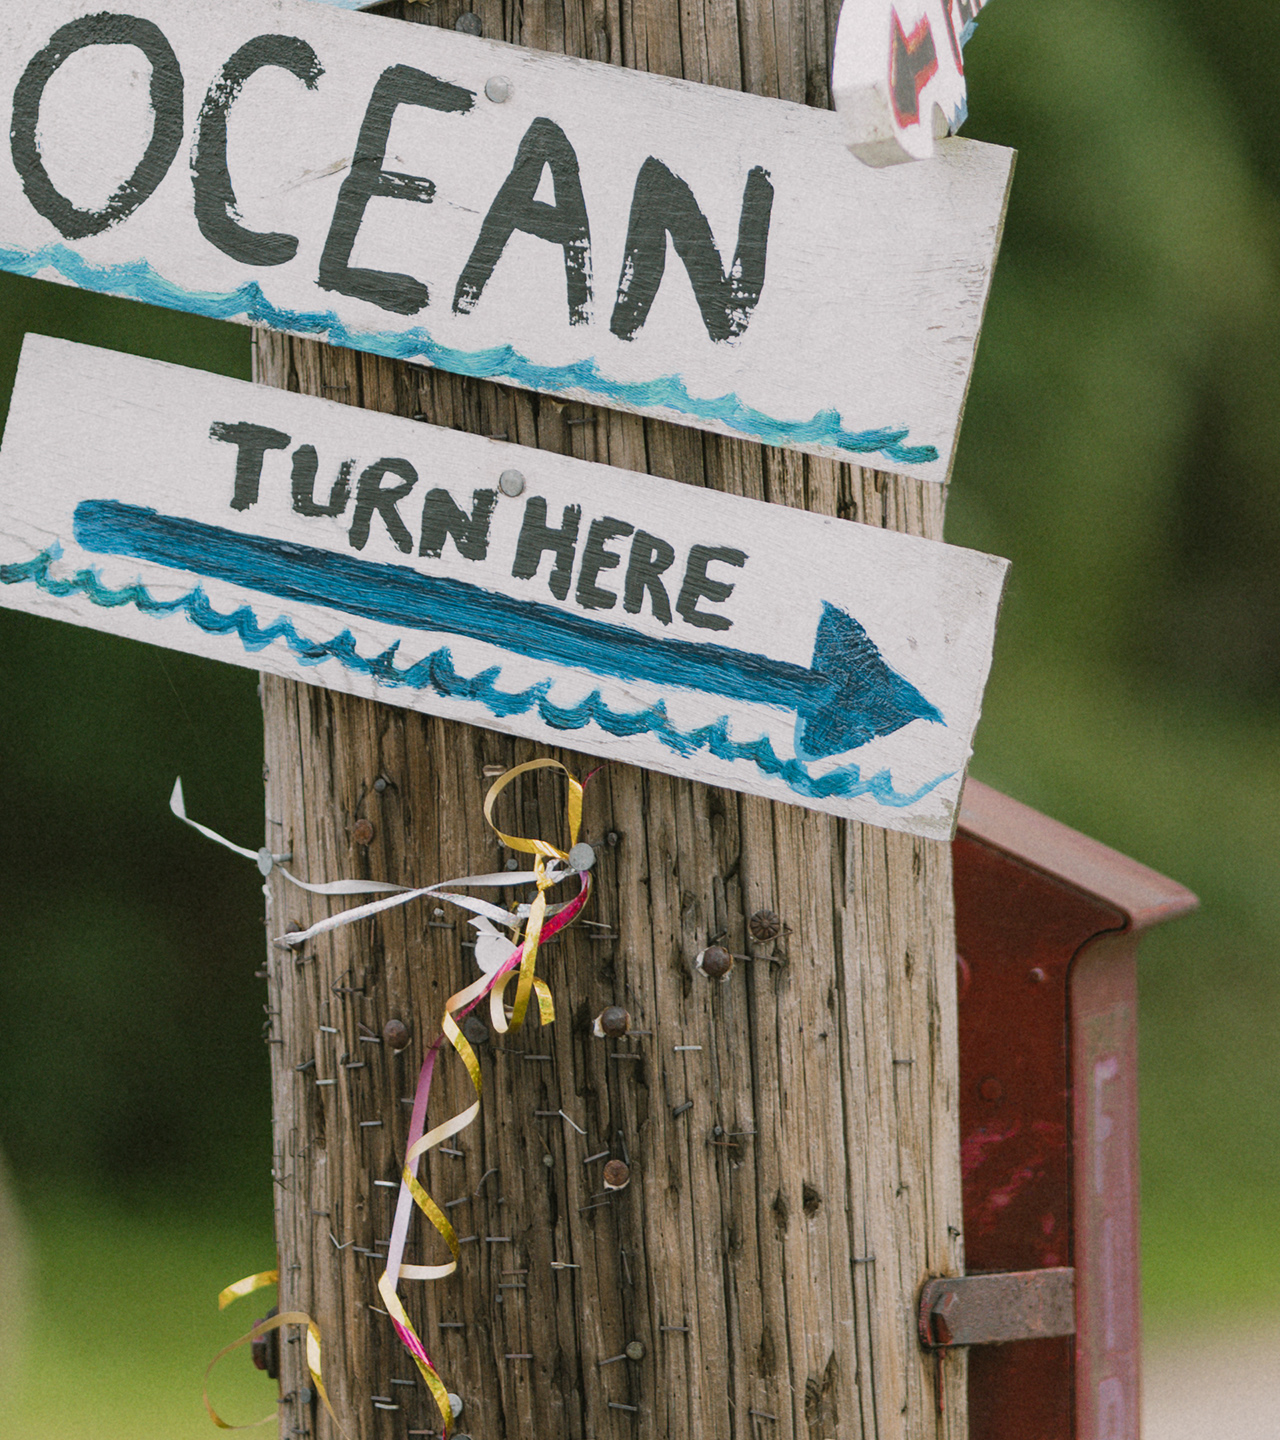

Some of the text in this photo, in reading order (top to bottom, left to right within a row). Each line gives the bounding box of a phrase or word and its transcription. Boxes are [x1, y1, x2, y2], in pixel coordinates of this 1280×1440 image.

[10, 12, 774, 343] OCEAN
[209, 420, 748, 632] TURN HERE
